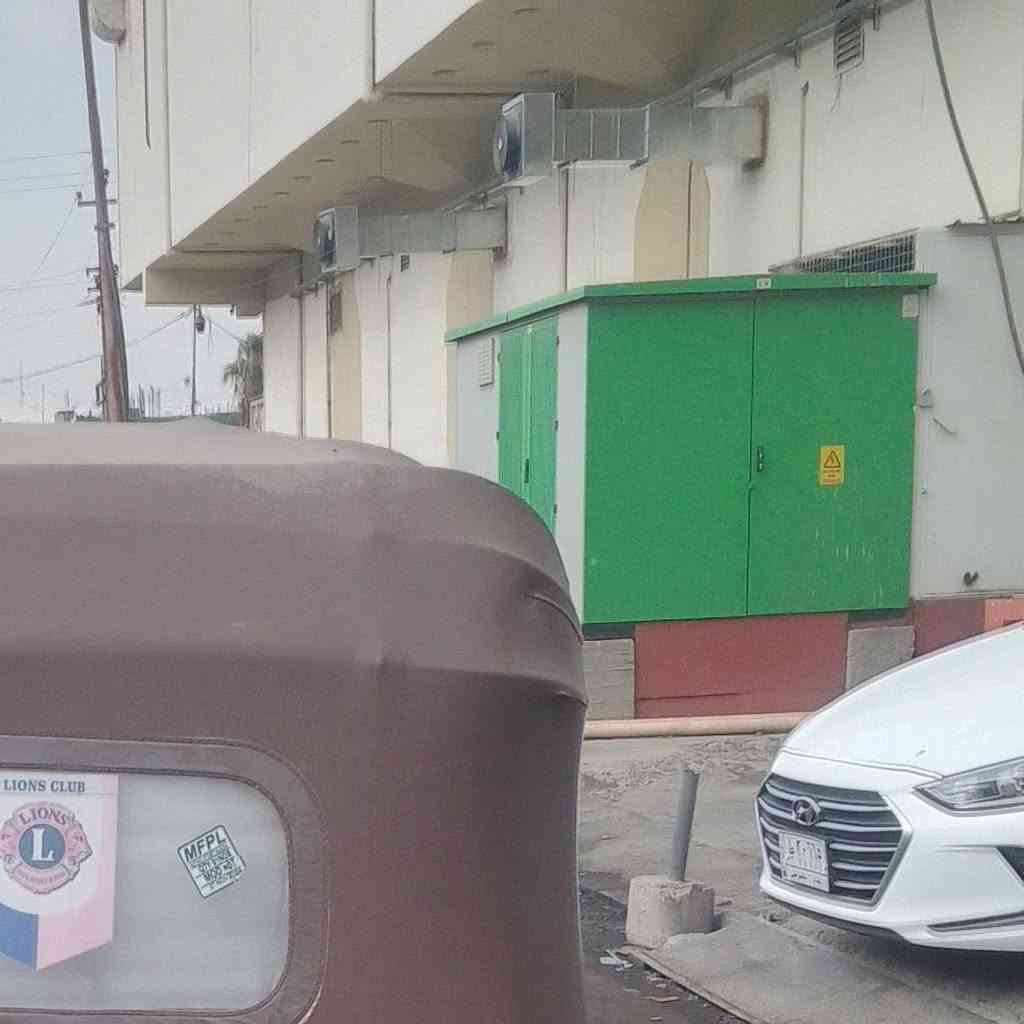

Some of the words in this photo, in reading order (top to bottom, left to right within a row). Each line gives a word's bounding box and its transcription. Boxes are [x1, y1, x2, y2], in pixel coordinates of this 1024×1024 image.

[3, 779, 47, 792] LIONS
[50, 781, 86, 793] CLUB
[18, 807, 68, 826] LIONS
[31, 827, 56, 861] L
[184, 830, 227, 863] MFPL
